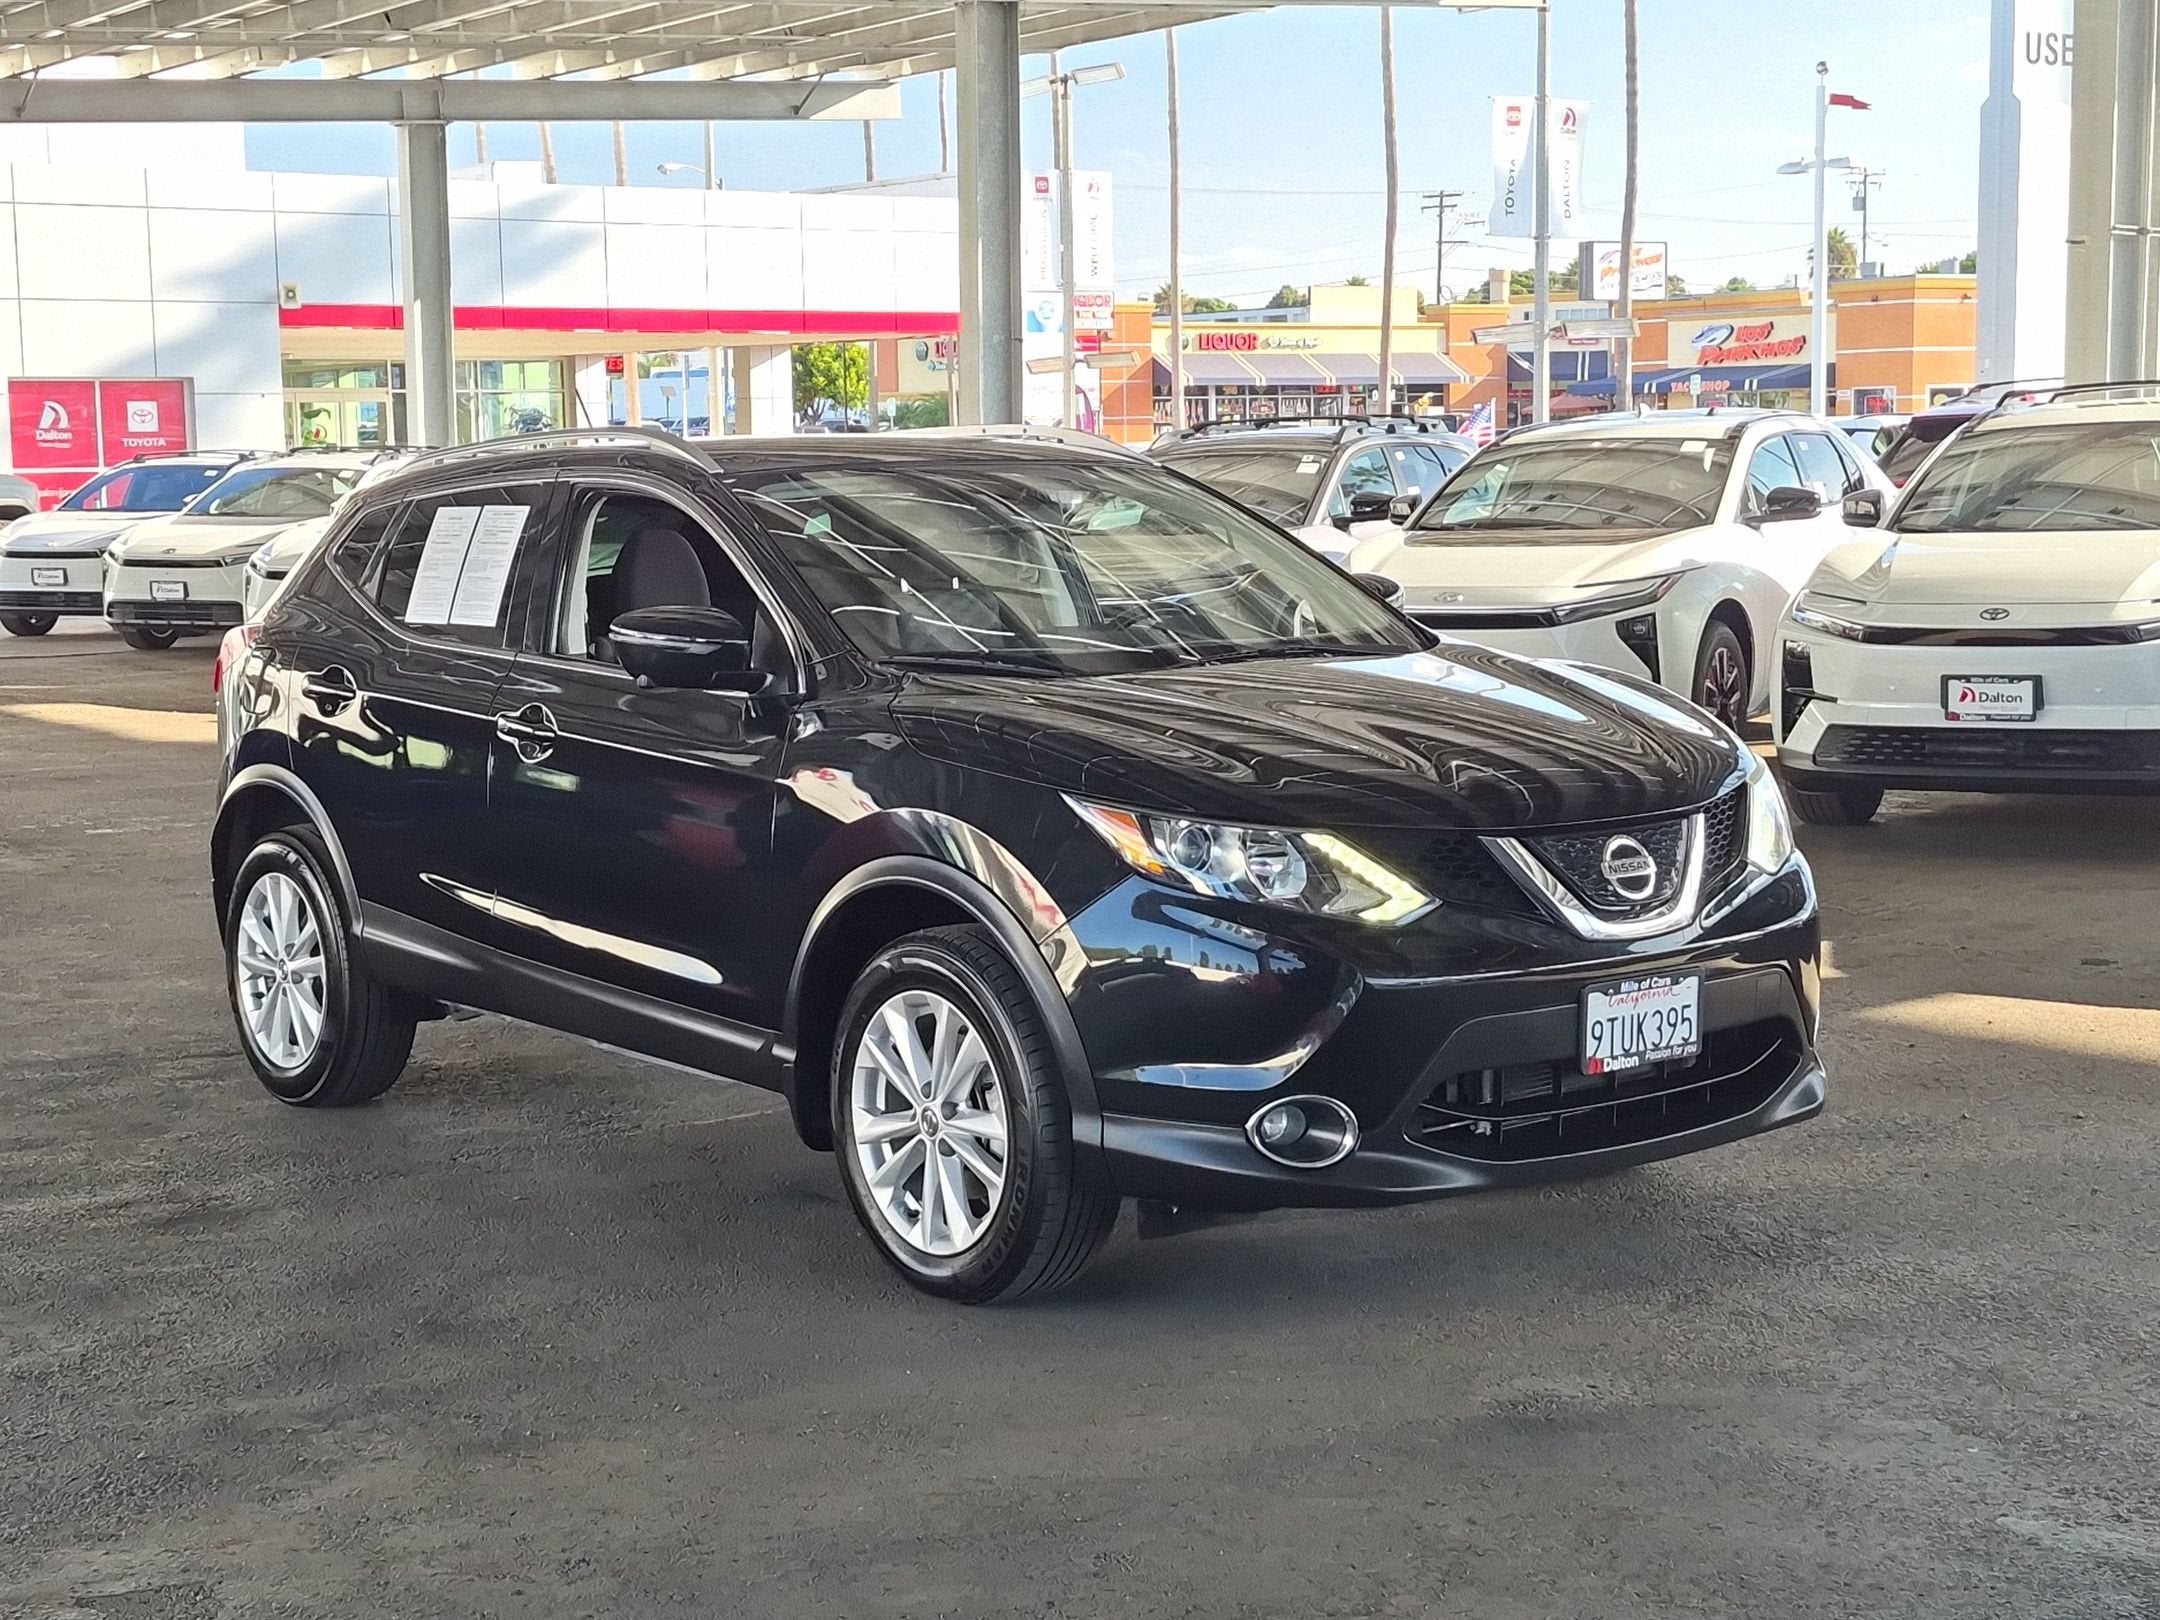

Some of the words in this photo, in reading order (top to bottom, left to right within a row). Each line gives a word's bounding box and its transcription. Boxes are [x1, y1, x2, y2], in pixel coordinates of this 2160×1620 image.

[1504, 158, 1516, 218] TOYOTA
[1199, 332, 1259, 351] LIQUOR
[1700, 379, 1731, 392] SHOP
[35, 430, 73, 441] Dalton
[122, 437, 167, 448] TOYOTA
[1978, 691, 2023, 703] Dalton
[1607, 860, 1651, 875] NISSAN
[1620, 981, 1639, 993] Mile
[1640, 979, 1650, 989] of
[1651, 976, 1672, 988] Cars
[1608, 985, 1681, 1010] California
[1591, 1003, 1693, 1058] 9TUK395
[1603, 1055, 1640, 1073] Dalton
[1645, 1047, 1672, 1061] Passion
[1672, 1044, 1684, 1056] for
[1684, 1043, 1698, 1056] you
